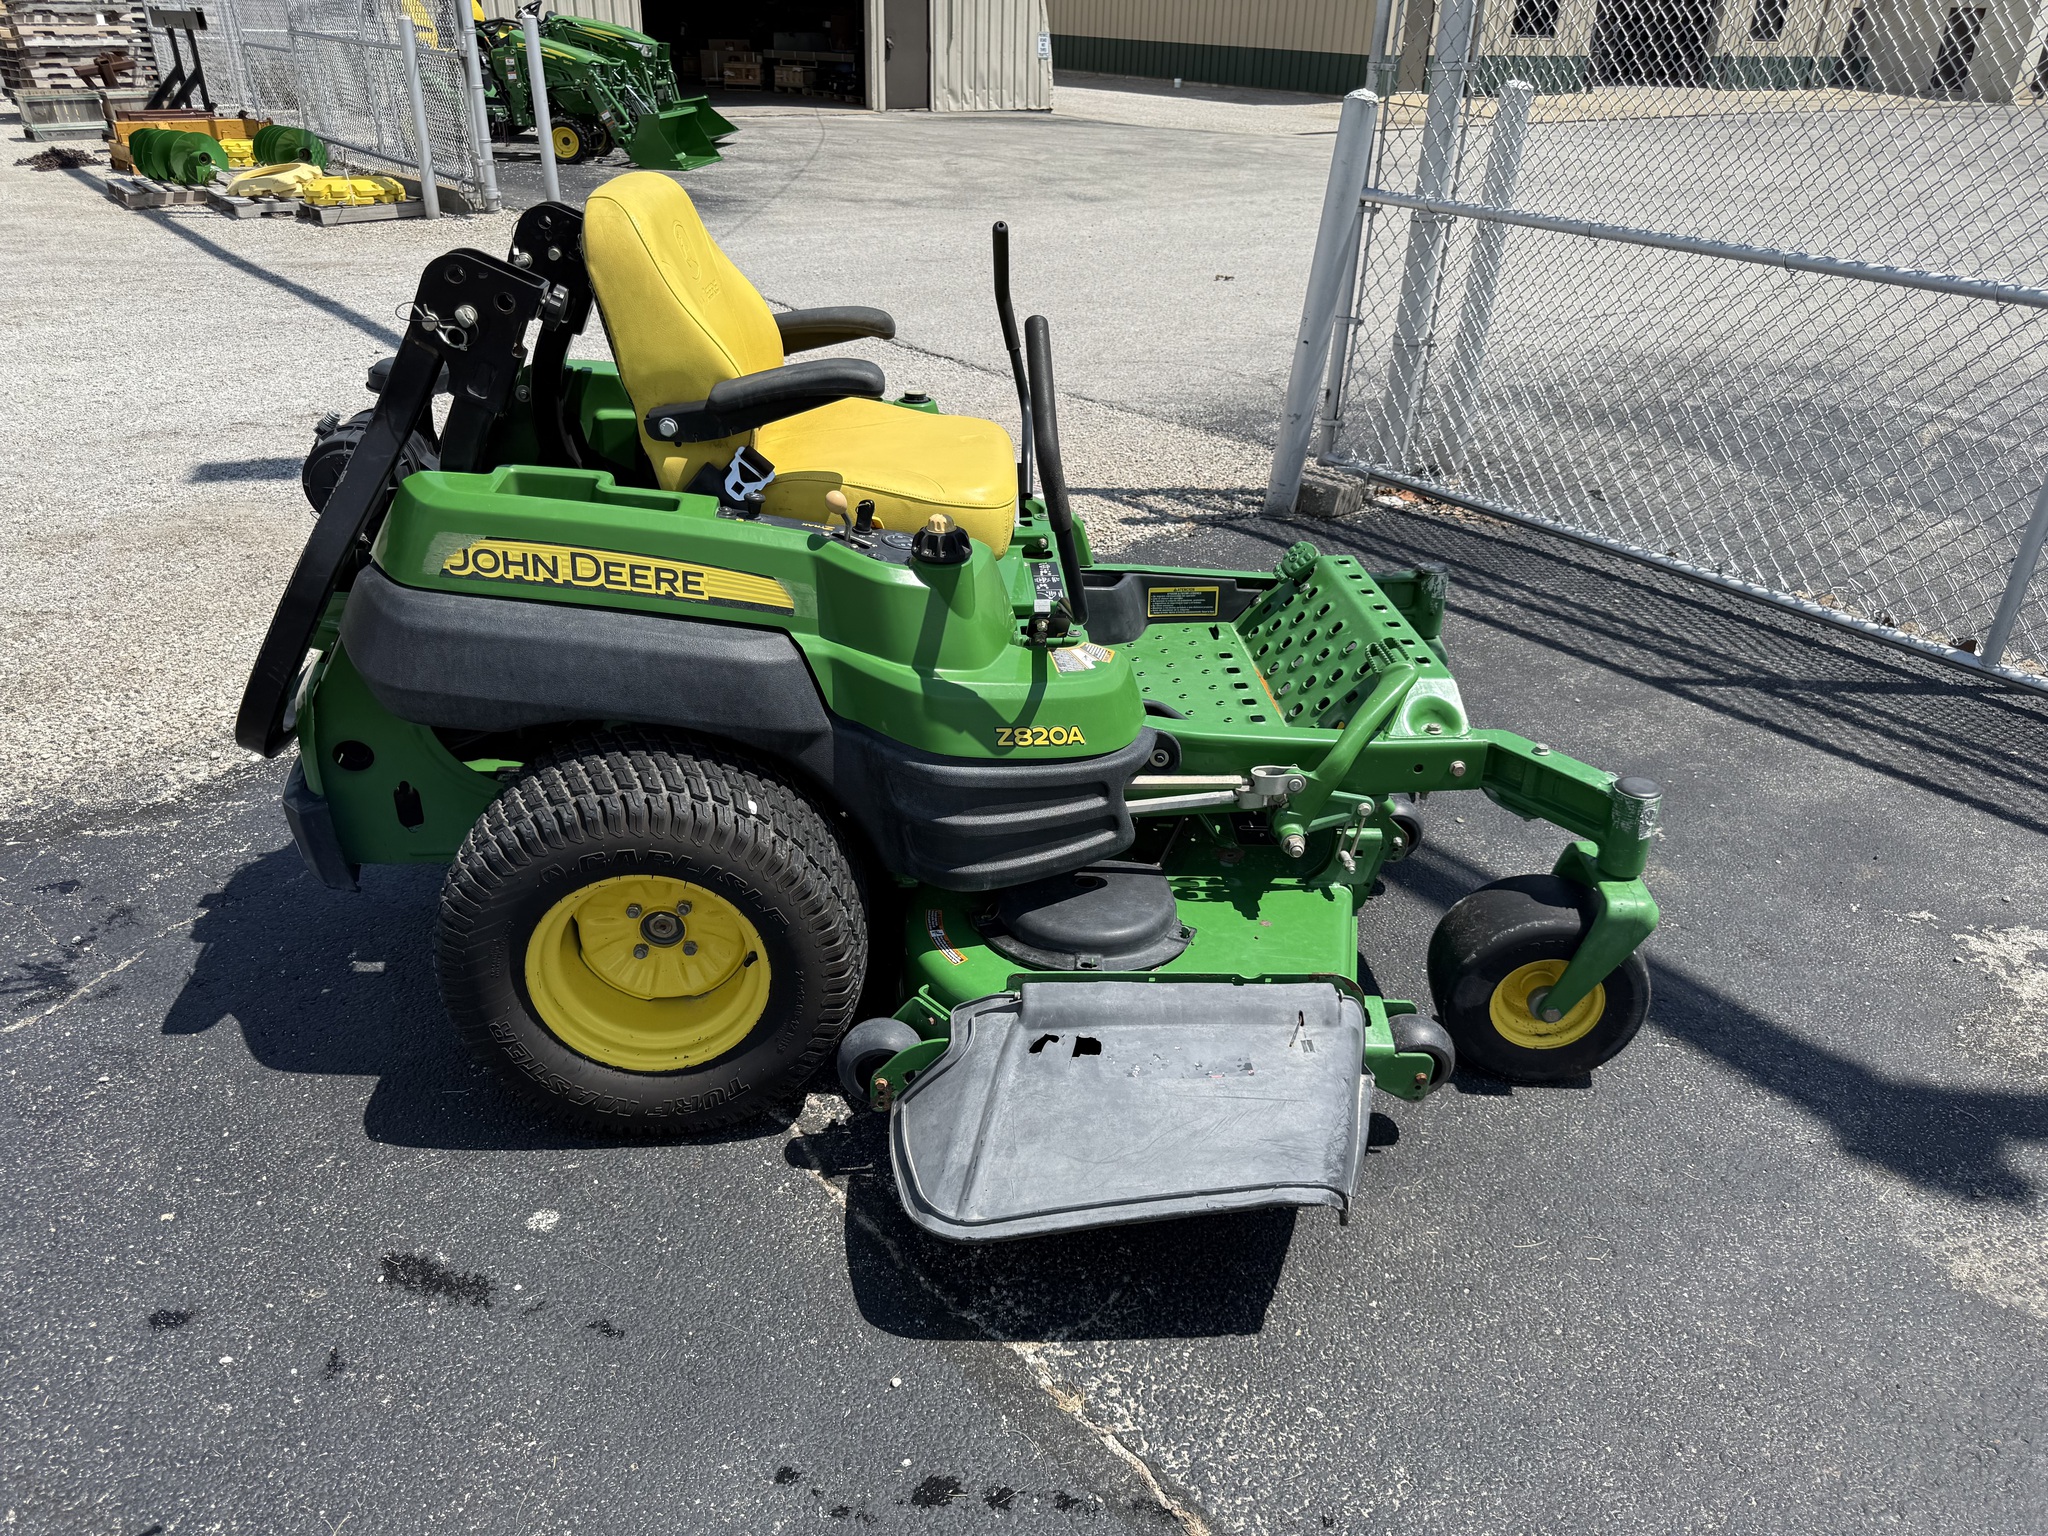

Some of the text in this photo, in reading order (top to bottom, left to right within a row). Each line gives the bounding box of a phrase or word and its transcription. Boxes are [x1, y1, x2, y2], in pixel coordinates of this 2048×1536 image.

[449, 547, 707, 598] JOHN DEERE
[995, 726, 1086, 747] Z820A
[577, 848, 790, 927] CARLISLE
[488, 1021, 752, 1118] TURF MASTER
